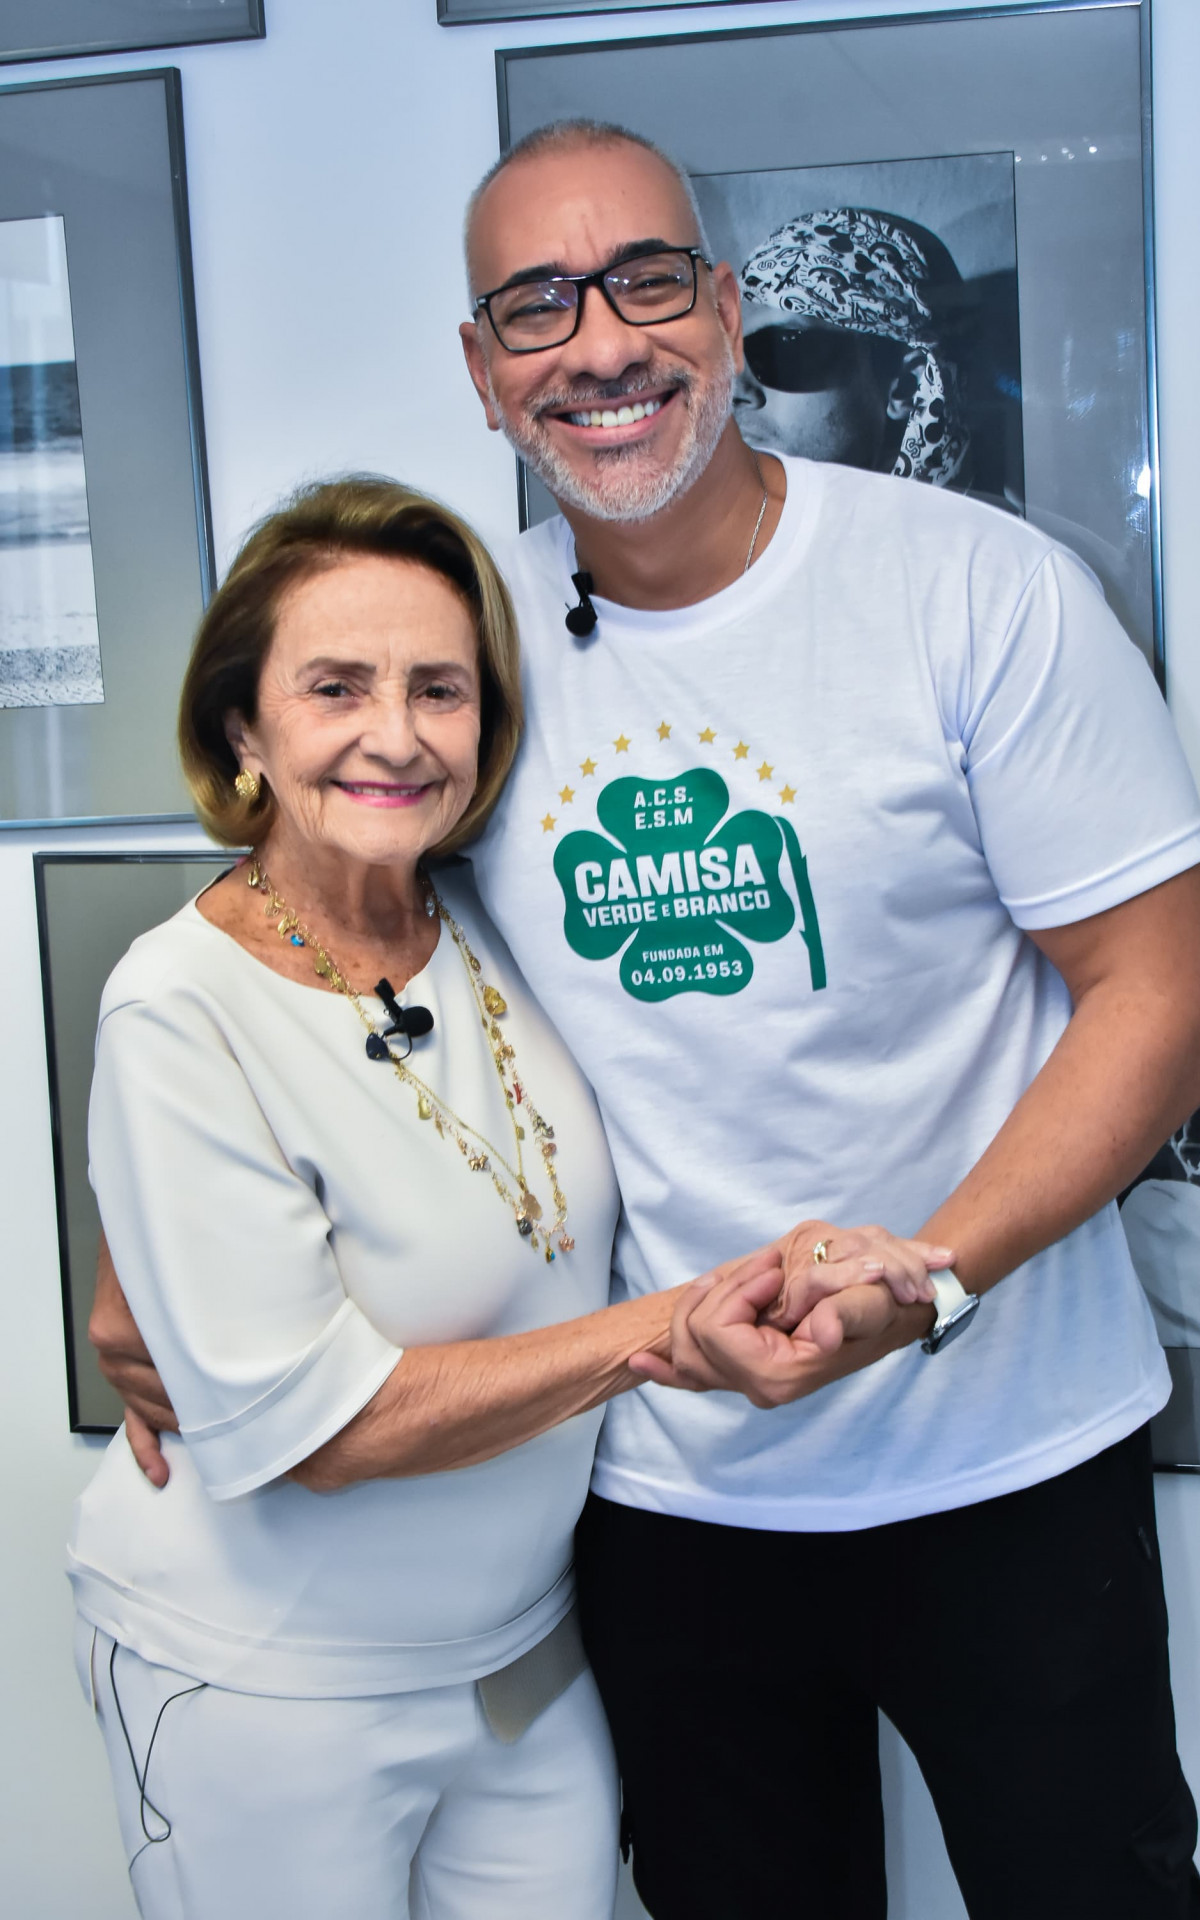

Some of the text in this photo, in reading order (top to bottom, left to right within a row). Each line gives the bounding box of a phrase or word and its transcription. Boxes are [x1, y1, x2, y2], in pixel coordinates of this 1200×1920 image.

[633, 786, 694, 808] A.C.S.
[634, 807, 693, 830] E.S.M
[574, 844, 766, 904] CAMISA
[582, 889, 771, 928] VERDE E BRANCO
[642, 943, 724, 963] FUNDADA EM
[631, 960, 743, 986] 04.09.1953
